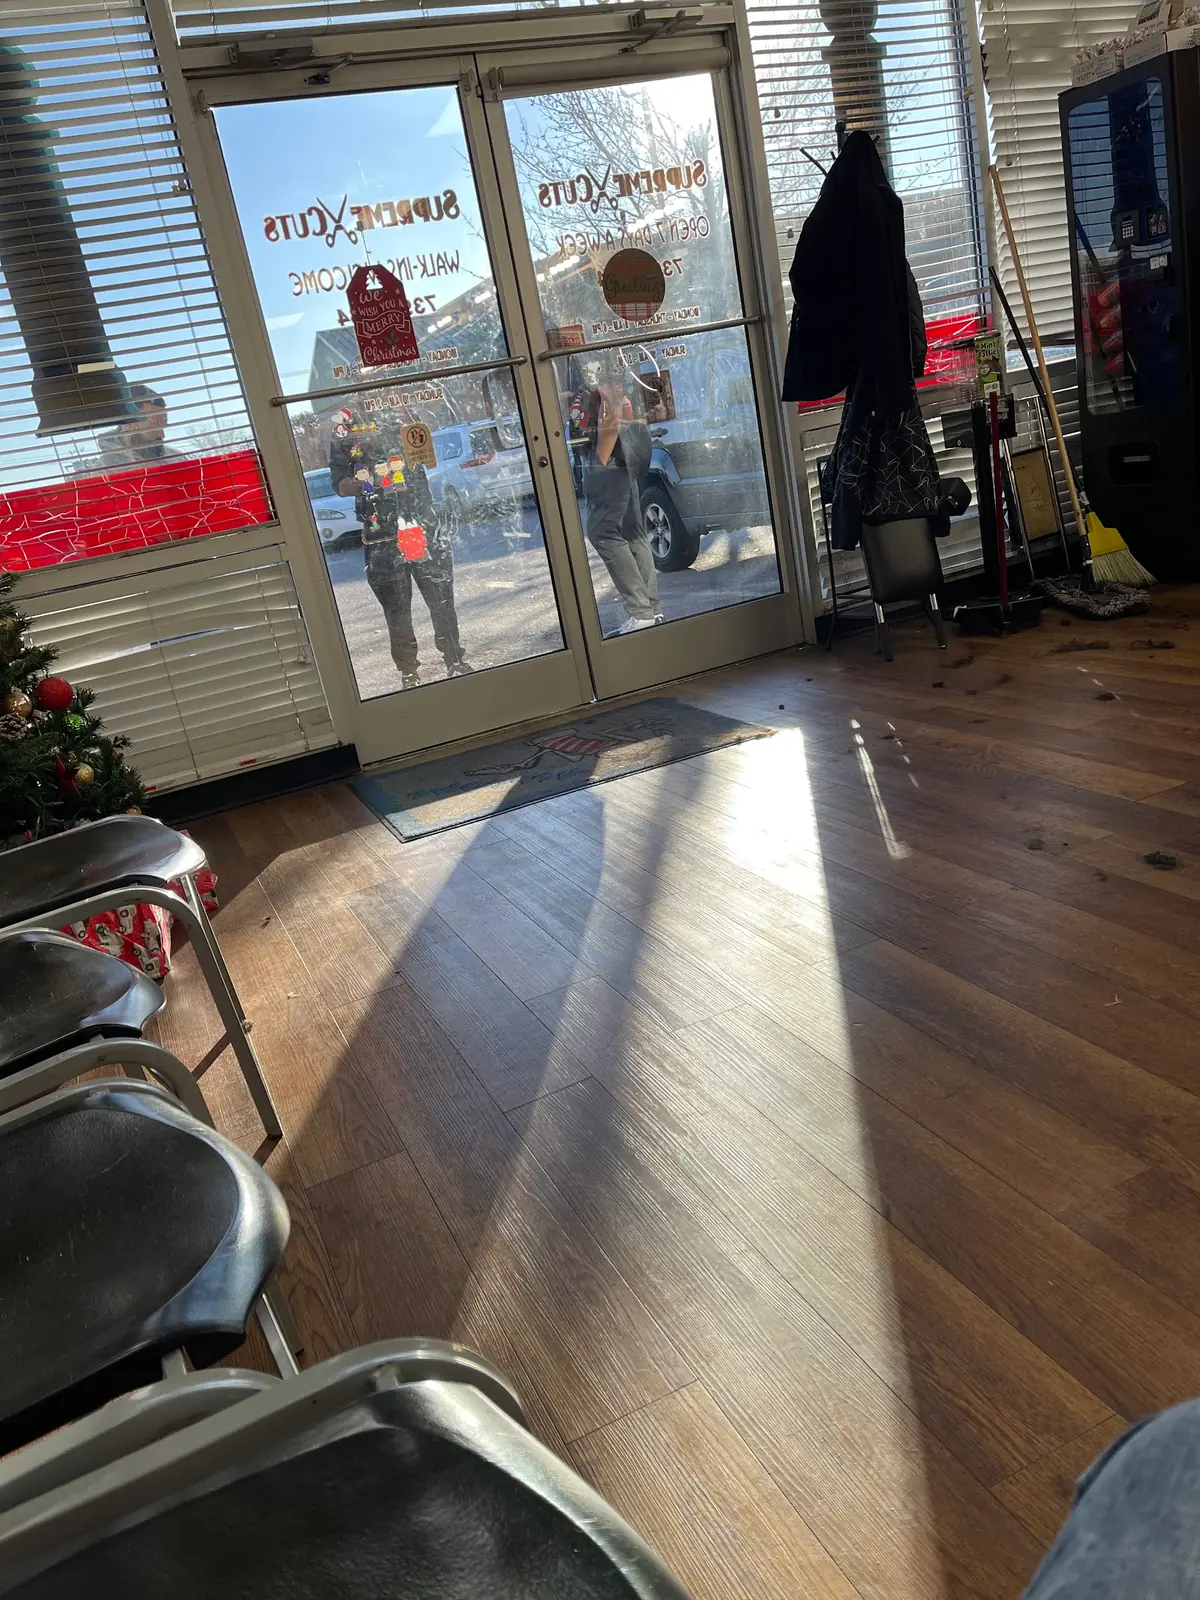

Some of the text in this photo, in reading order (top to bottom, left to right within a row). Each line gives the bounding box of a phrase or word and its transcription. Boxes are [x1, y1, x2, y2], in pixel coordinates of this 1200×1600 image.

[357, 306, 379, 318] WISH
[379, 298, 396, 312] YOU
[398, 299, 405, 309] A
[365, 312, 401, 332] MERRY
[363, 344, 416, 364] Christmas
